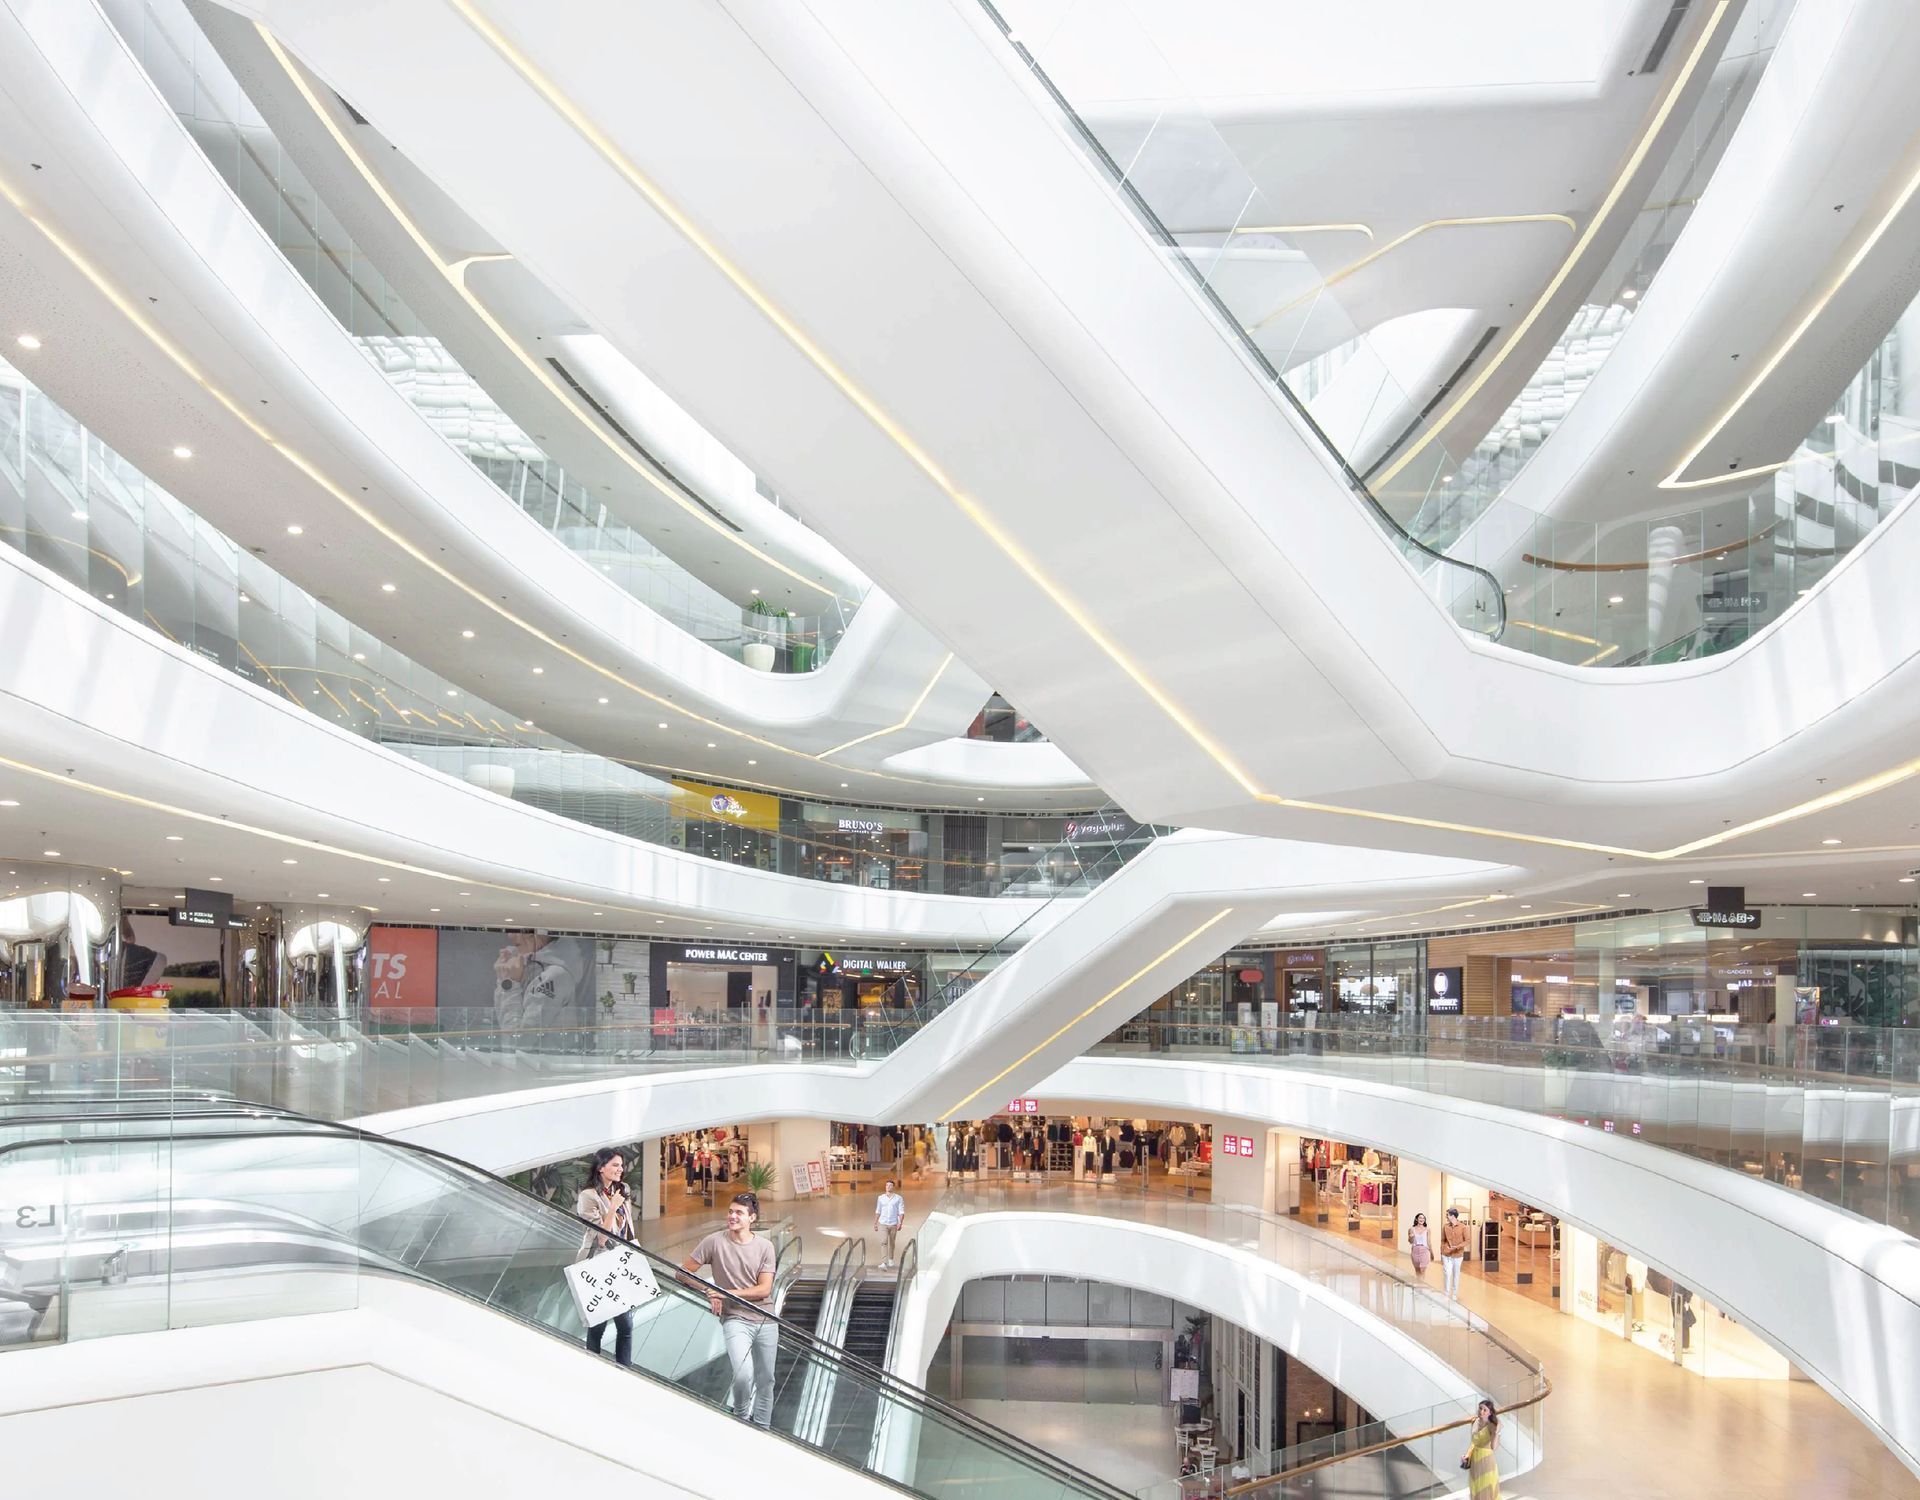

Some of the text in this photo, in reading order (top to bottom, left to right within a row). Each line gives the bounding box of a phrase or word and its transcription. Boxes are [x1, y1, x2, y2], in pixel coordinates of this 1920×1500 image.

[838, 819, 883, 831] BRUNO'S
[179, 911, 187, 920] L3
[685, 949, 768, 961] POWER MAC CENTER
[371, 953, 408, 980] TS
[843, 960, 906, 970] DIGITAL WALKER
[621, 1268, 643, 1285] SAC
[580, 1270, 598, 1287] CUL
[606, 1290, 620, 1302] DE
[586, 1294, 603, 1313] CUL
[604, 1271, 618, 1286] DE
